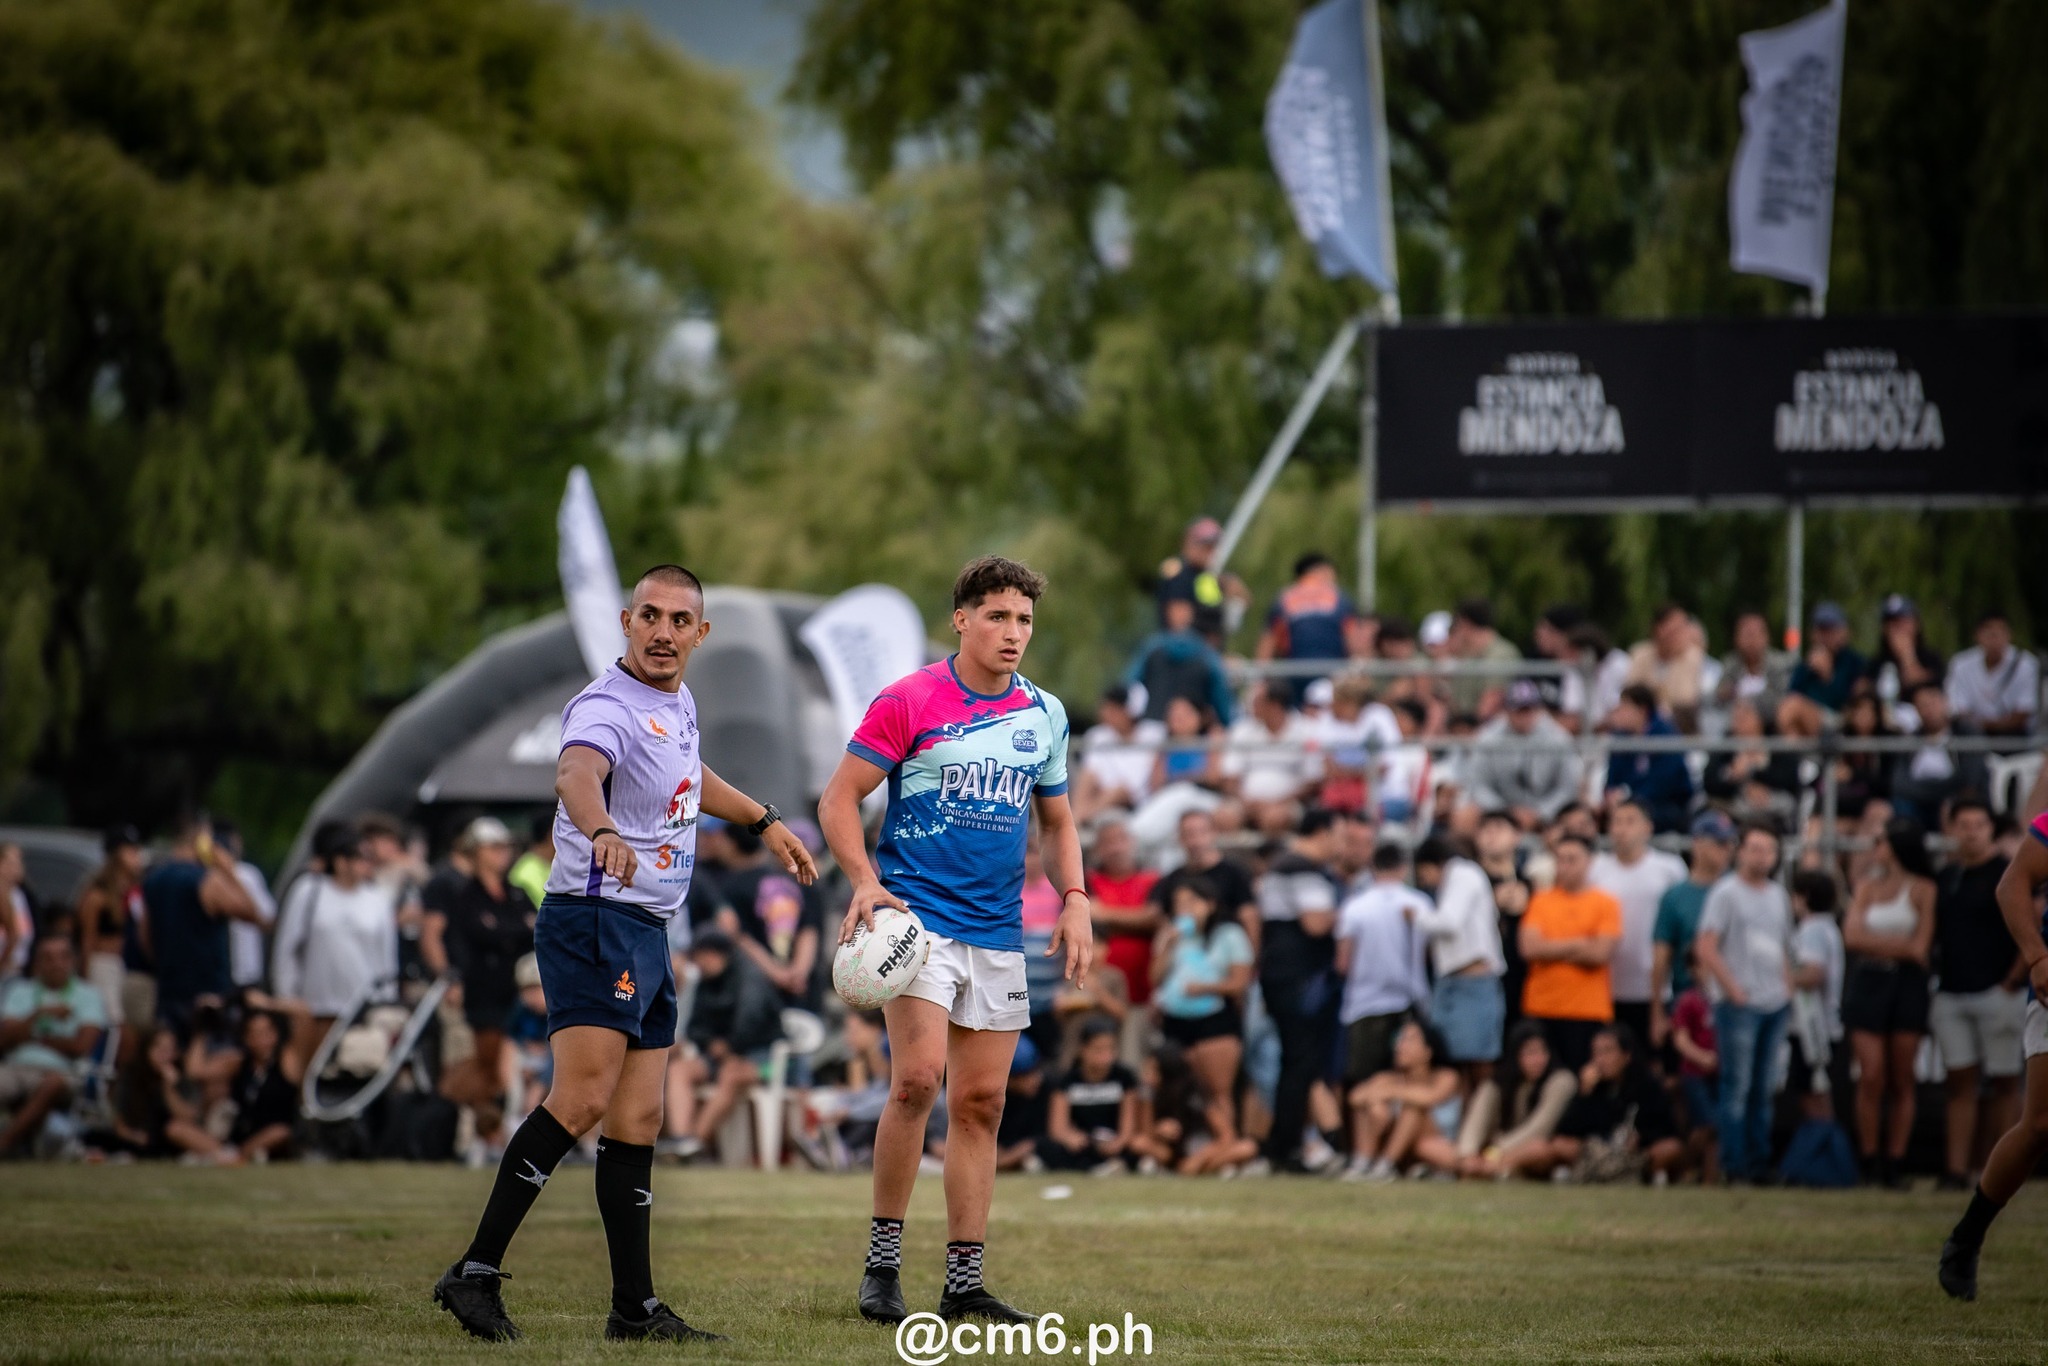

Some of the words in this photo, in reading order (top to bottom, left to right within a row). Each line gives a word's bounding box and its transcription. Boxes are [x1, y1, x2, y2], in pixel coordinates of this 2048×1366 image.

[1477, 374, 1606, 409] ESTANCIA
[1793, 371, 1925, 406] ESTANCIA
[1458, 406, 1625, 455] MENDOZA
[1774, 402, 1945, 450] MENDOZA
[1013, 739, 1036, 747] SEVEN
[940, 758, 1033, 812] PALAU
[953, 818, 1013, 833] HIPERTERMAL
[970, 811, 993, 822] AGUA
[877, 924, 919, 979] RHINO
[615, 991, 633, 1001] URT
